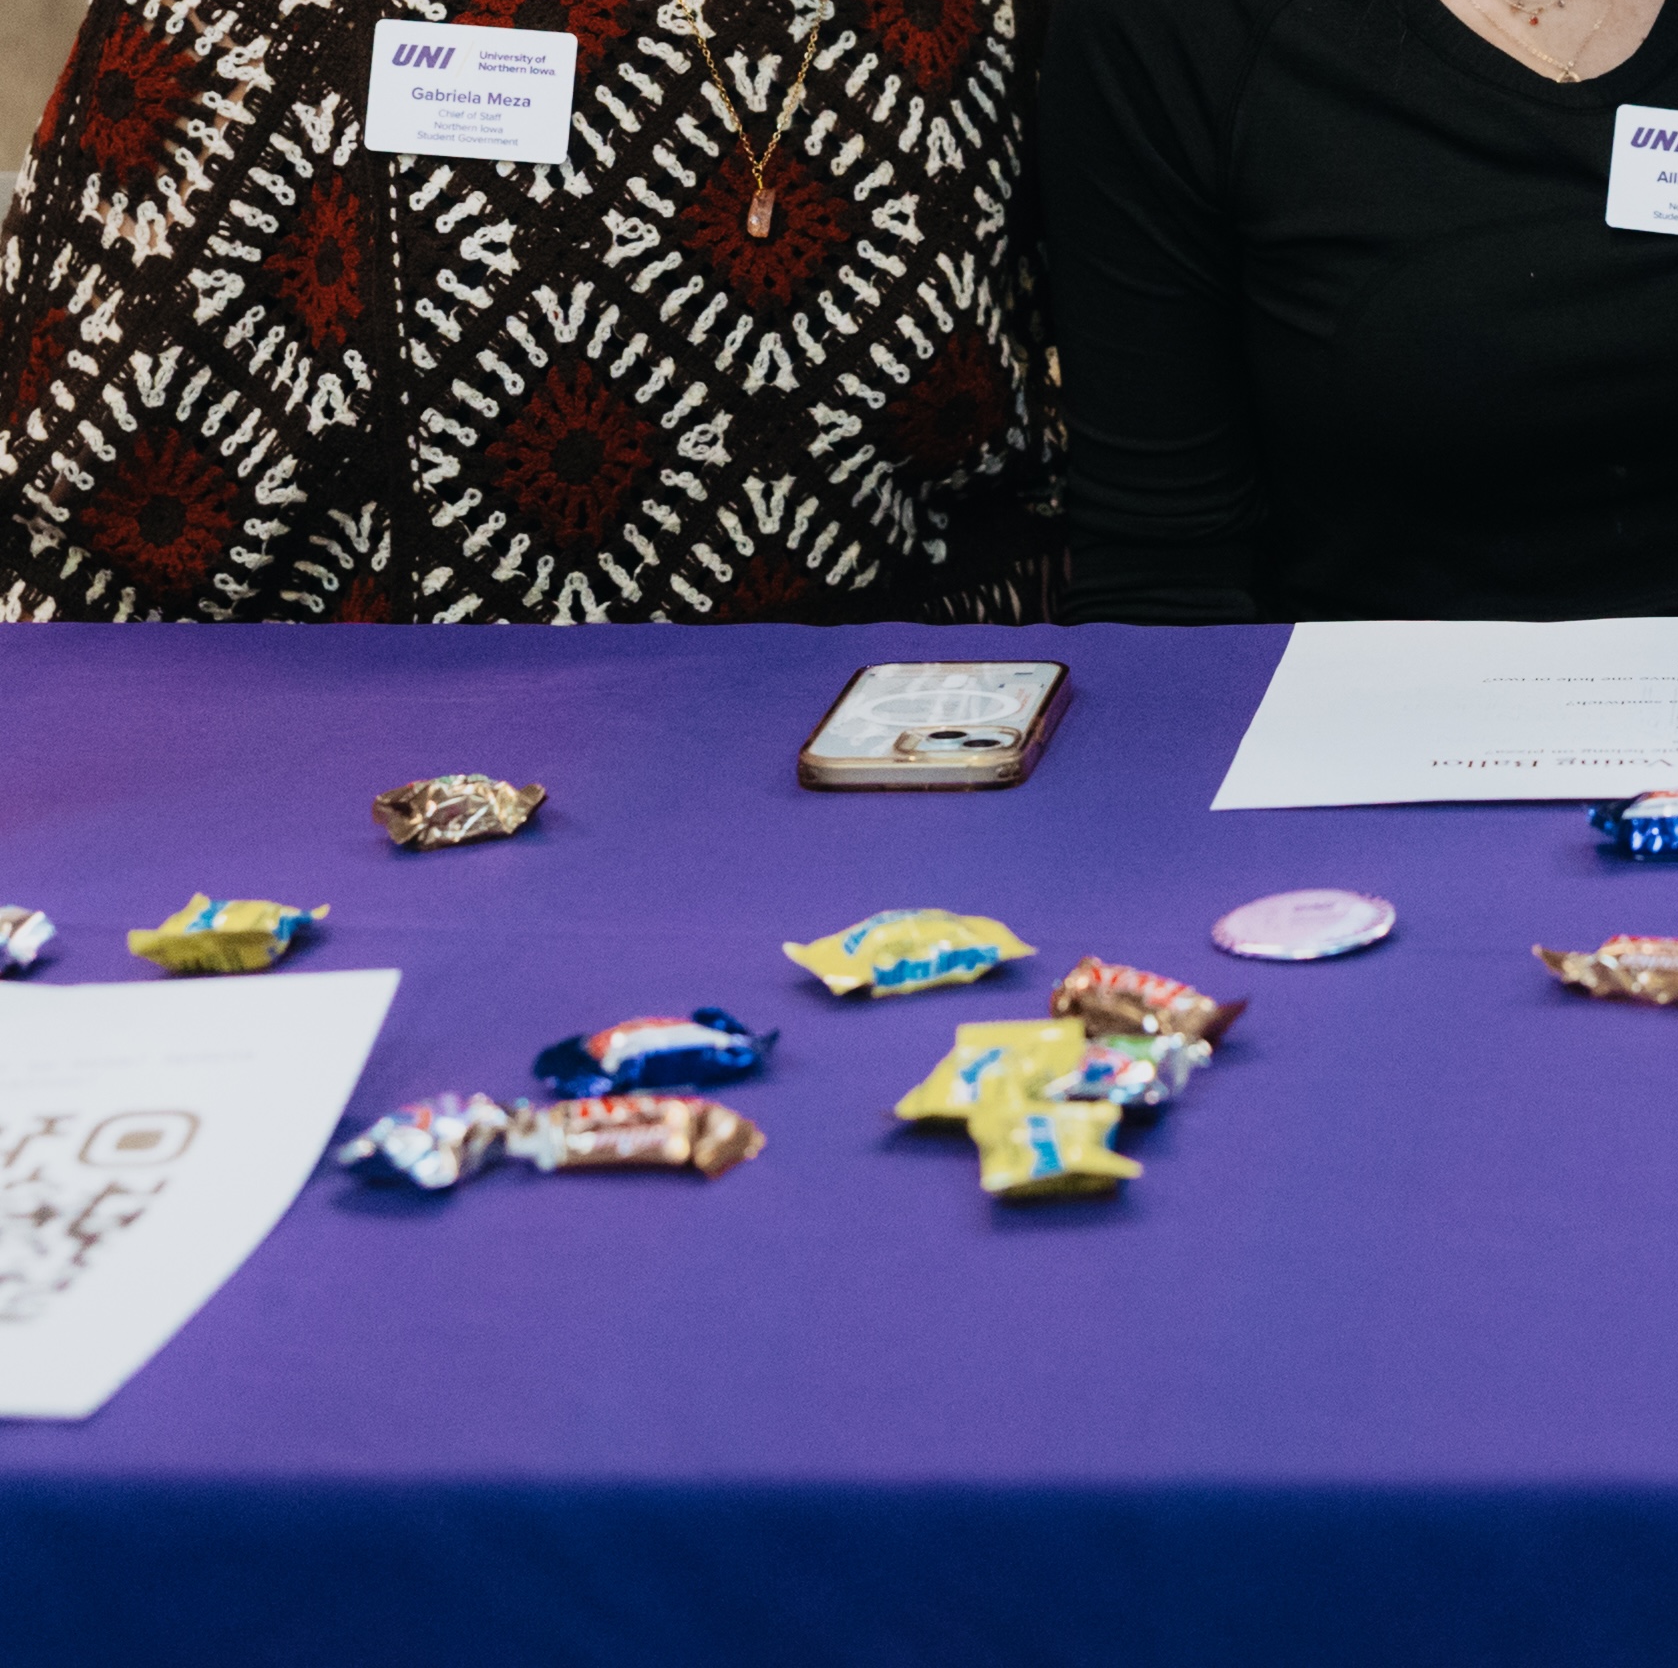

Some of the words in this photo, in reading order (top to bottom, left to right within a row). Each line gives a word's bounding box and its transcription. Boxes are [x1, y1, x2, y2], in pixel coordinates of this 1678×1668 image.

[392, 44, 455, 69] UNI
[480, 51, 533, 64] University
[535, 55, 546, 64] of
[478, 62, 526, 74] Northern
[412, 87, 481, 105] Gabriela
[487, 93, 531, 107] Meza
[438, 109, 464, 119] Chief
[467, 111, 477, 120] of
[480, 112, 502, 121] Staff
[434, 122, 477, 132] Northern
[480, 125, 503, 133] Iowa
[417, 132, 455, 142] Student
[458, 135, 518, 146] Government
[1430, 759, 1540, 768] Ballot
[1557, 757, 1673, 768] Voting
